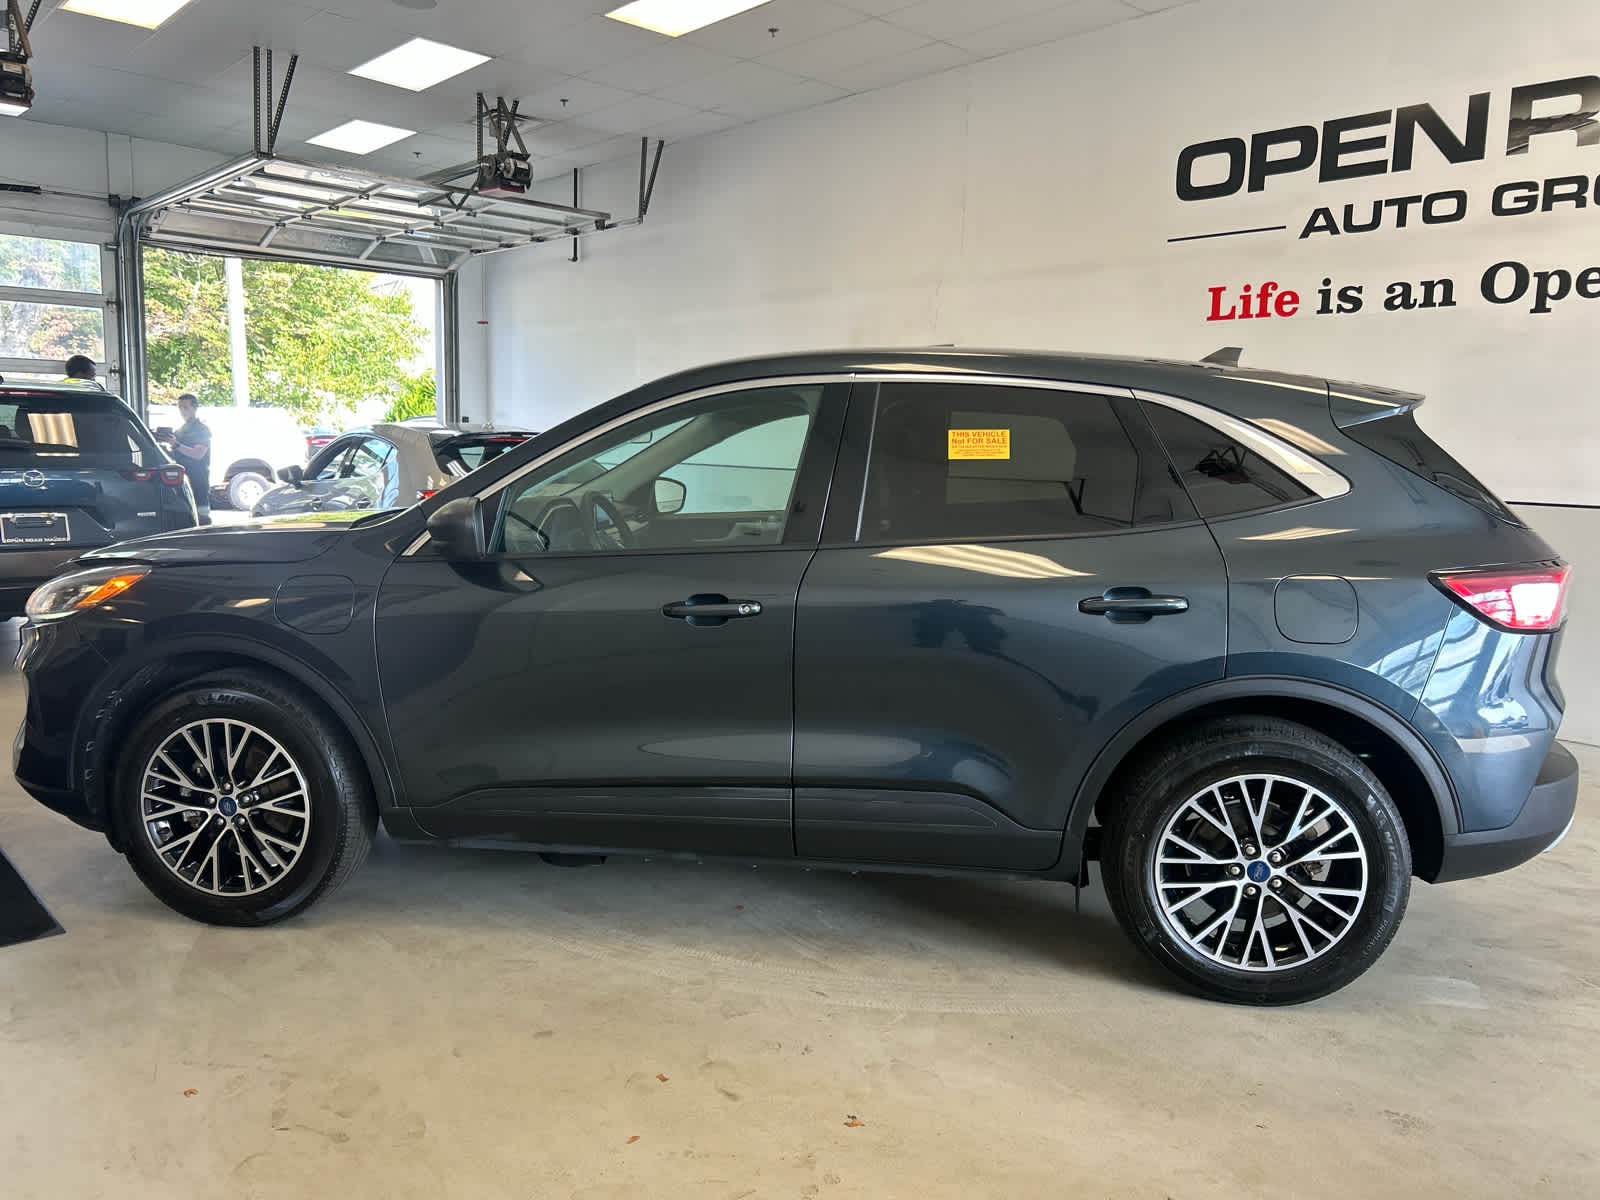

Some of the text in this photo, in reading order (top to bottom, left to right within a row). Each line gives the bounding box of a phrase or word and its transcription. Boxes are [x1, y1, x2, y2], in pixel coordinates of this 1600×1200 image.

[1175, 92, 1491, 202] OPEN
[1298, 174, 1600, 240] AUTO GR
[1206, 260, 1600, 322] Life is an Ope
[966, 437, 984, 445] FOR
[985, 437, 1007, 445] SALE
